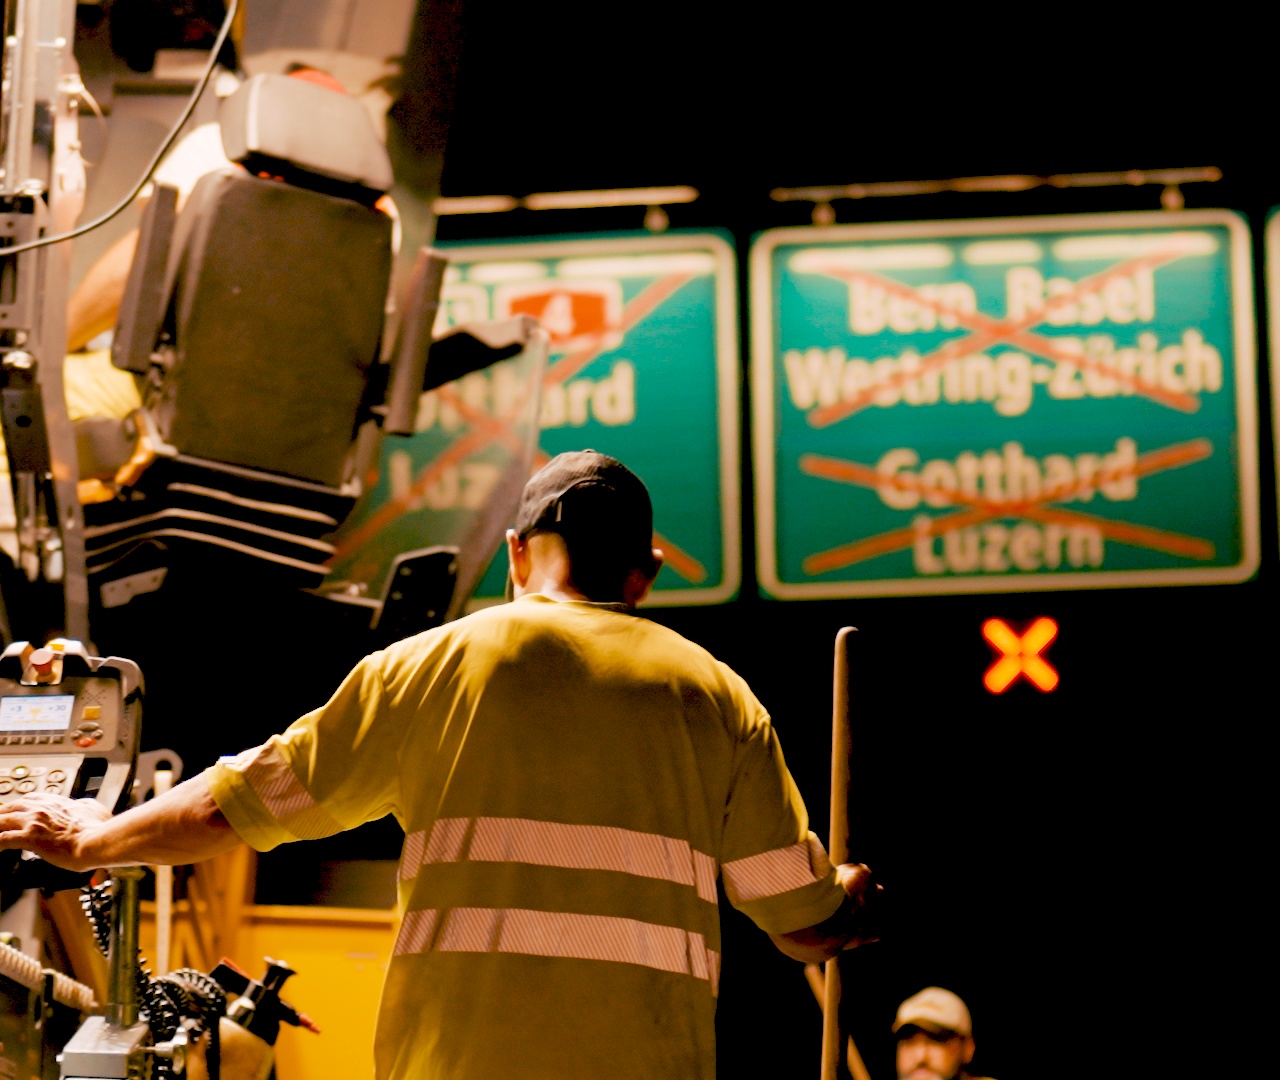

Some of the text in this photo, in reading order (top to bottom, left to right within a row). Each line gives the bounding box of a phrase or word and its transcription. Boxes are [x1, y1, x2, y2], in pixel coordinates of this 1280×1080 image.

[542, 293, 576, 335] 4
[849, 265, 1154, 335] Bern Basel
[784, 327, 1222, 417] Westring-Zürich
[874, 436, 1139, 511] Gotthard
[913, 514, 1105, 575] Luzern
